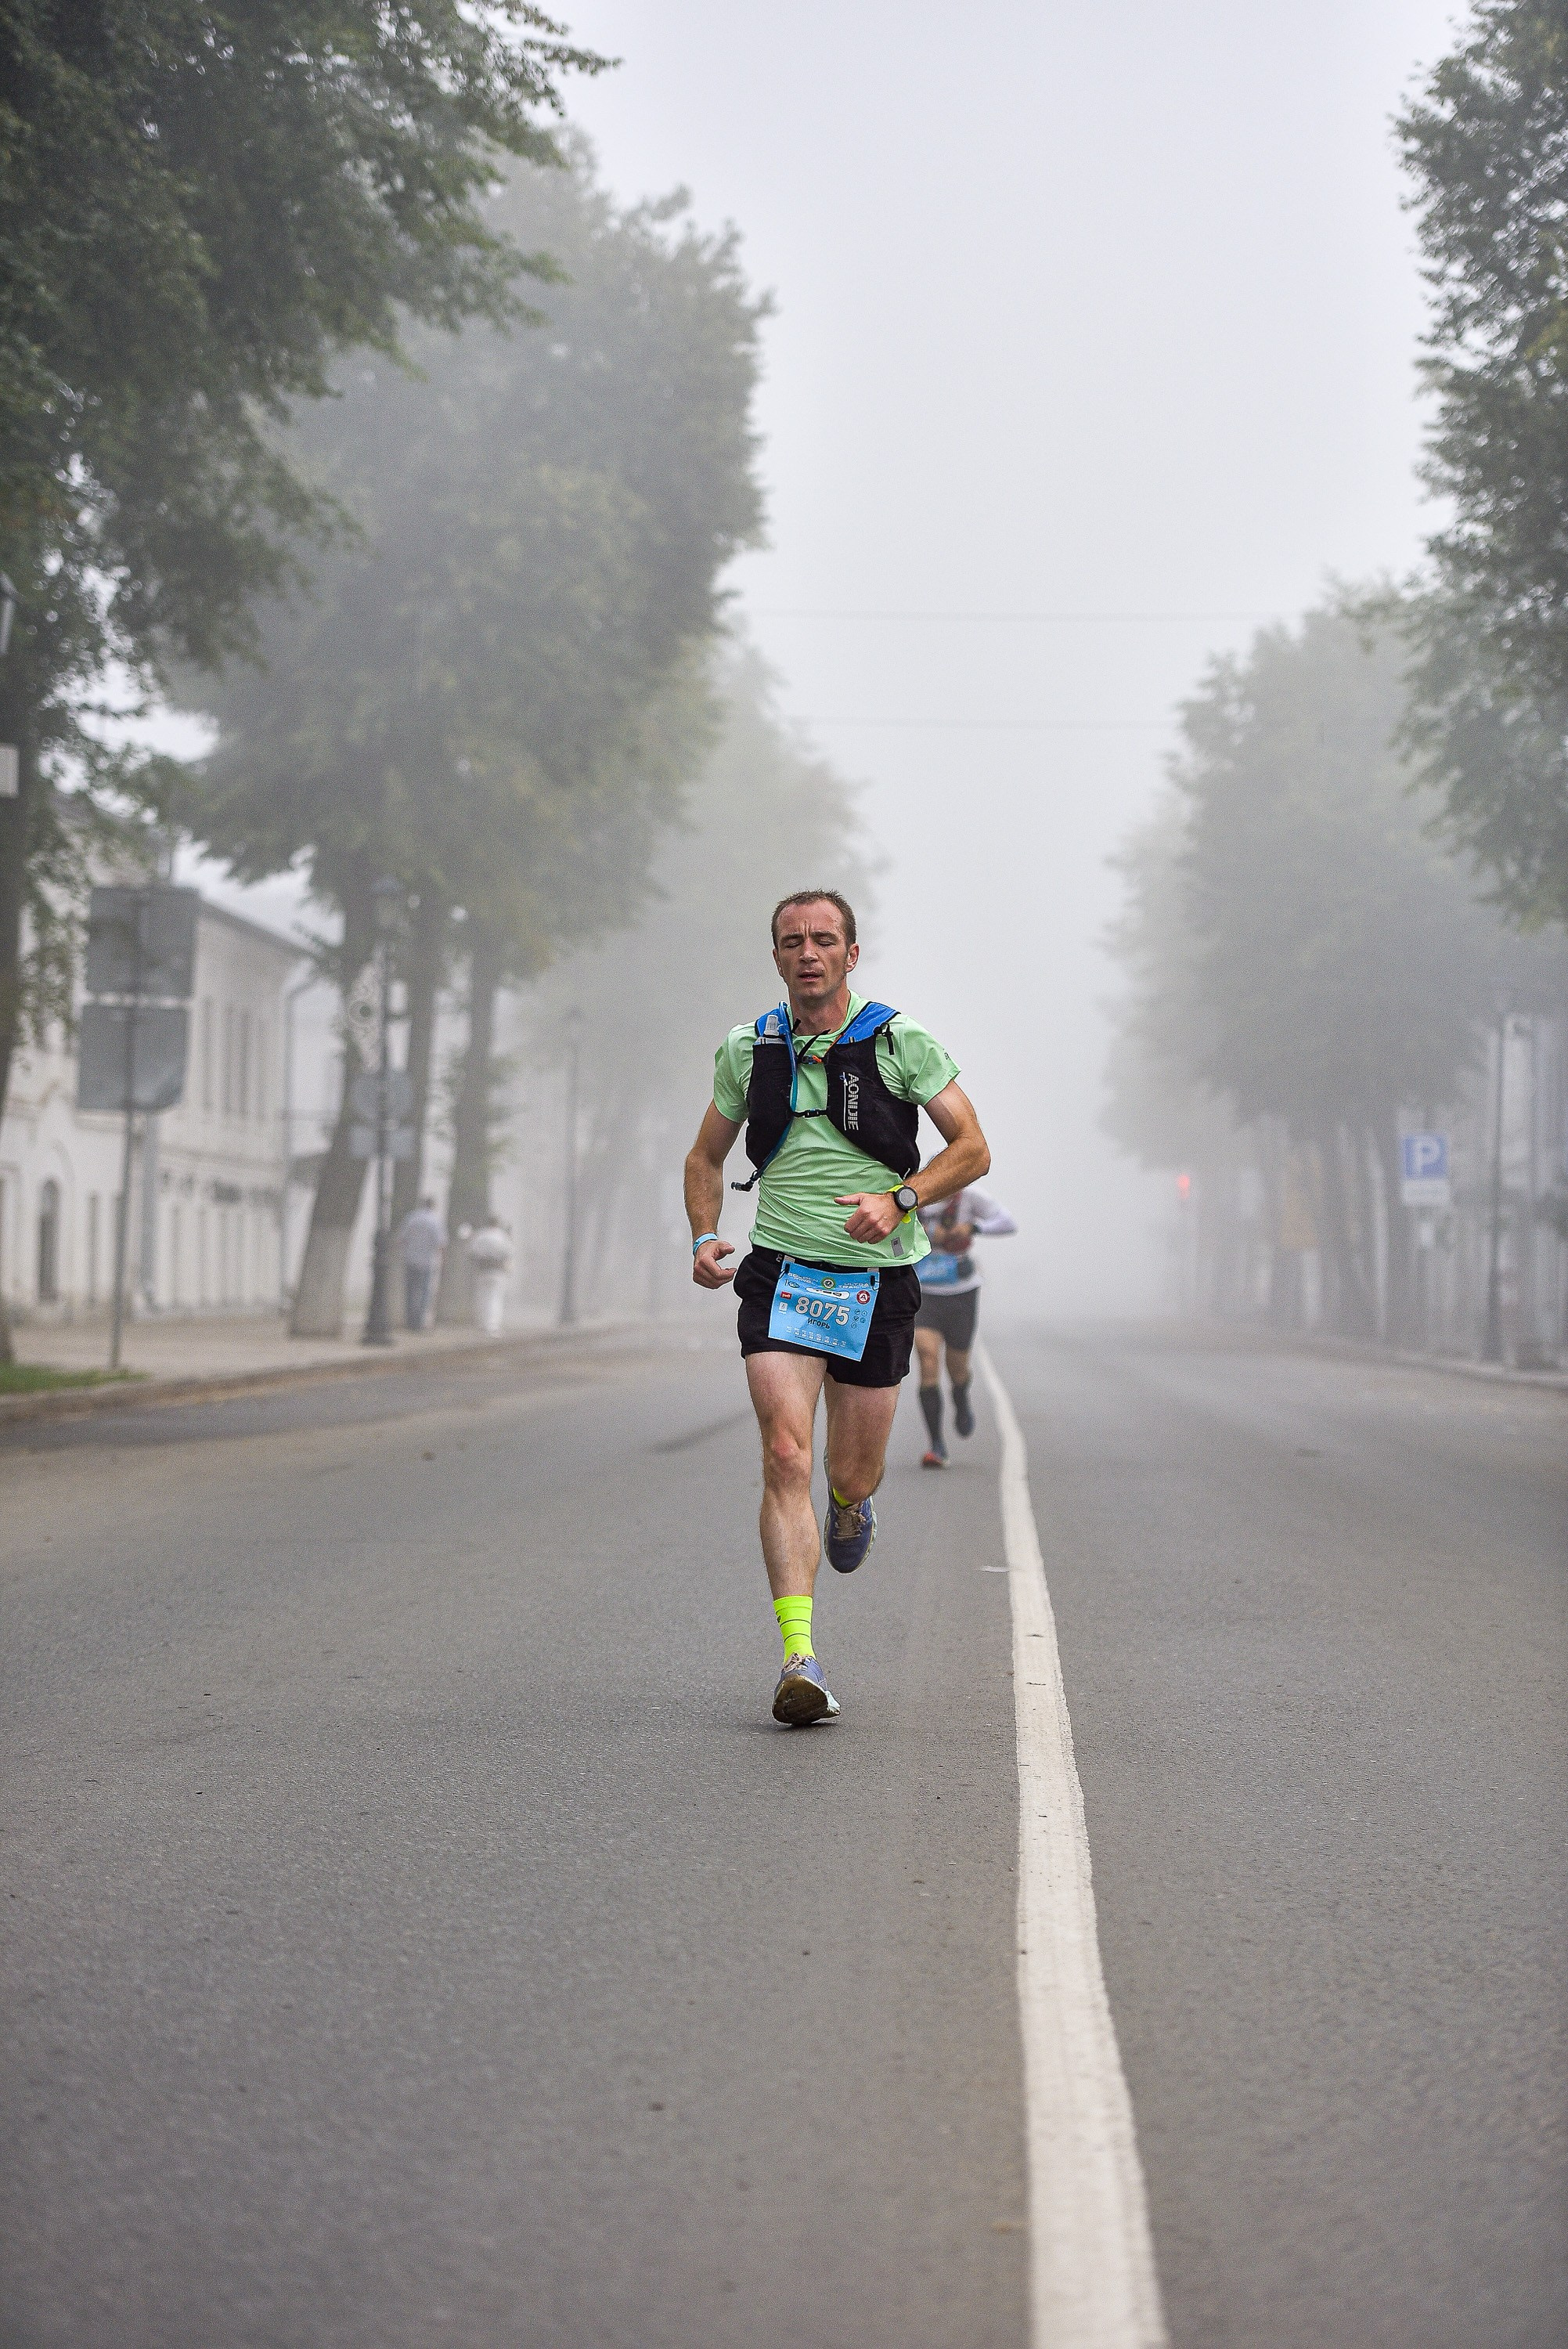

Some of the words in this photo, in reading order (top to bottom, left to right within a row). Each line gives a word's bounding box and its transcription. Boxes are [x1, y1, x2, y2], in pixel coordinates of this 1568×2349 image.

[848, 1073, 859, 1131] AONIJIE
[1415, 1137, 1440, 1176] P
[795, 1297, 850, 1326] 8075
[807, 1318, 831, 1329] ИГОРЬ
